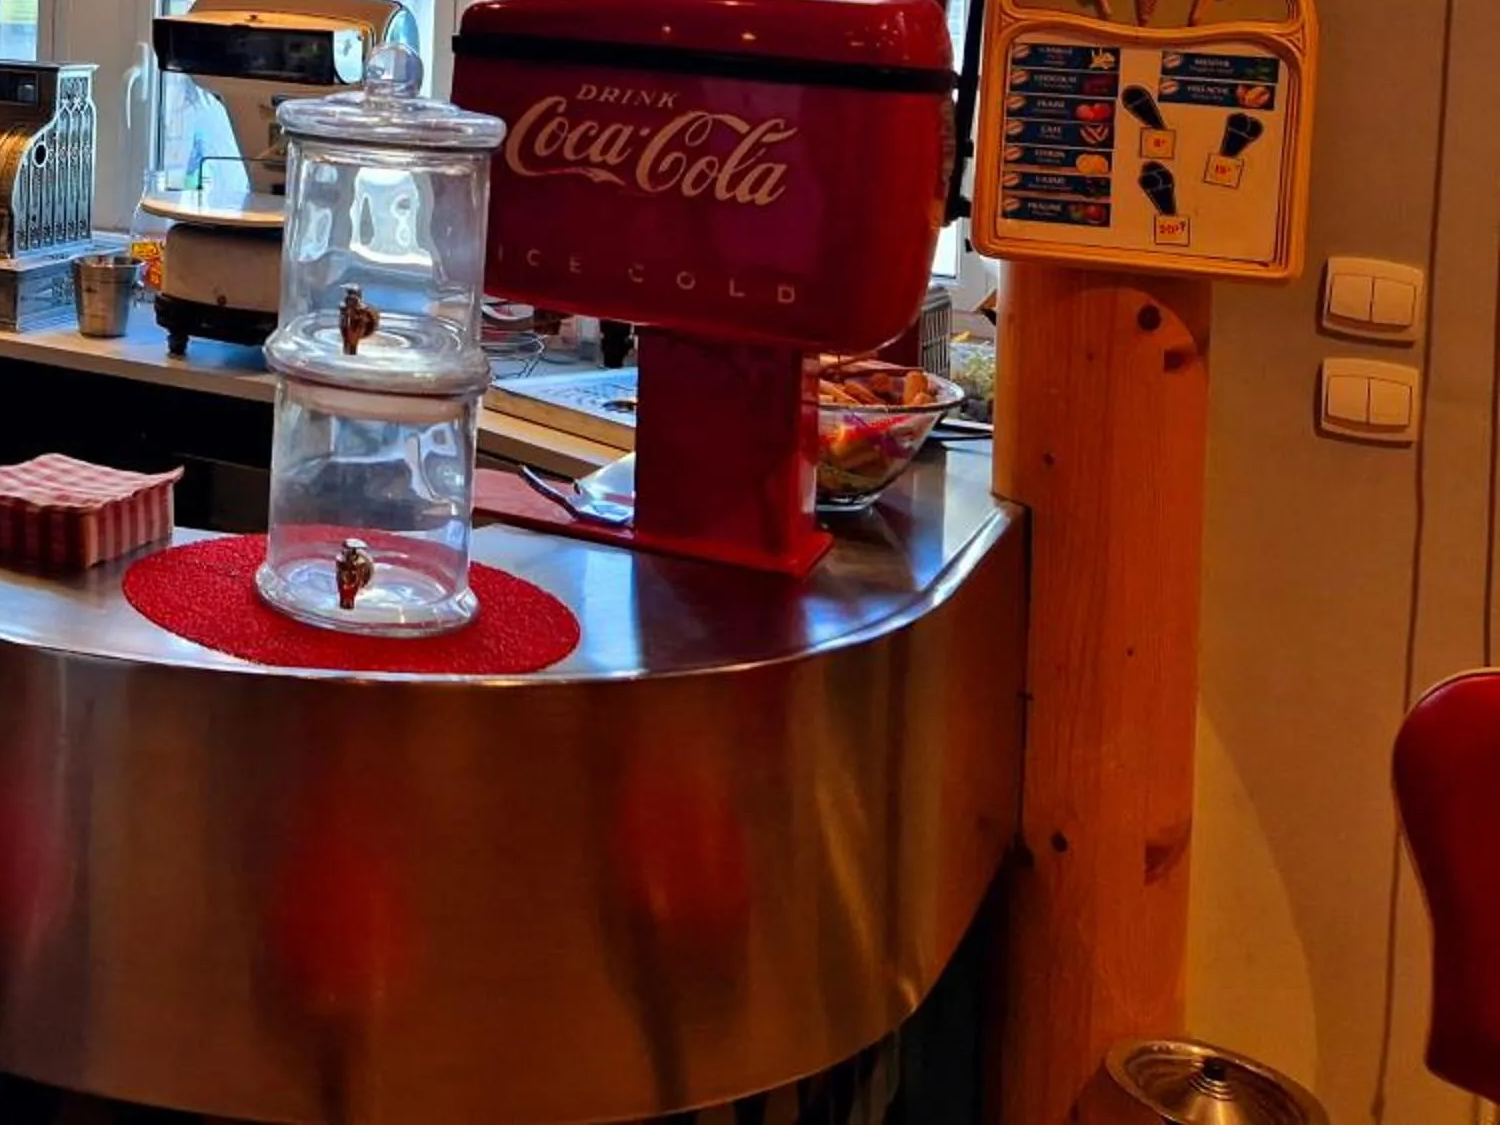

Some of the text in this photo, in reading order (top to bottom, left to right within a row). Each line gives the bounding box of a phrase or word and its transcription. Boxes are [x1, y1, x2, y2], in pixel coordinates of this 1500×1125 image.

[576, 83, 680, 109] DRINK
[505, 95, 798, 206] Coca-Cola
[499, 244, 796, 304] ICE COLD
